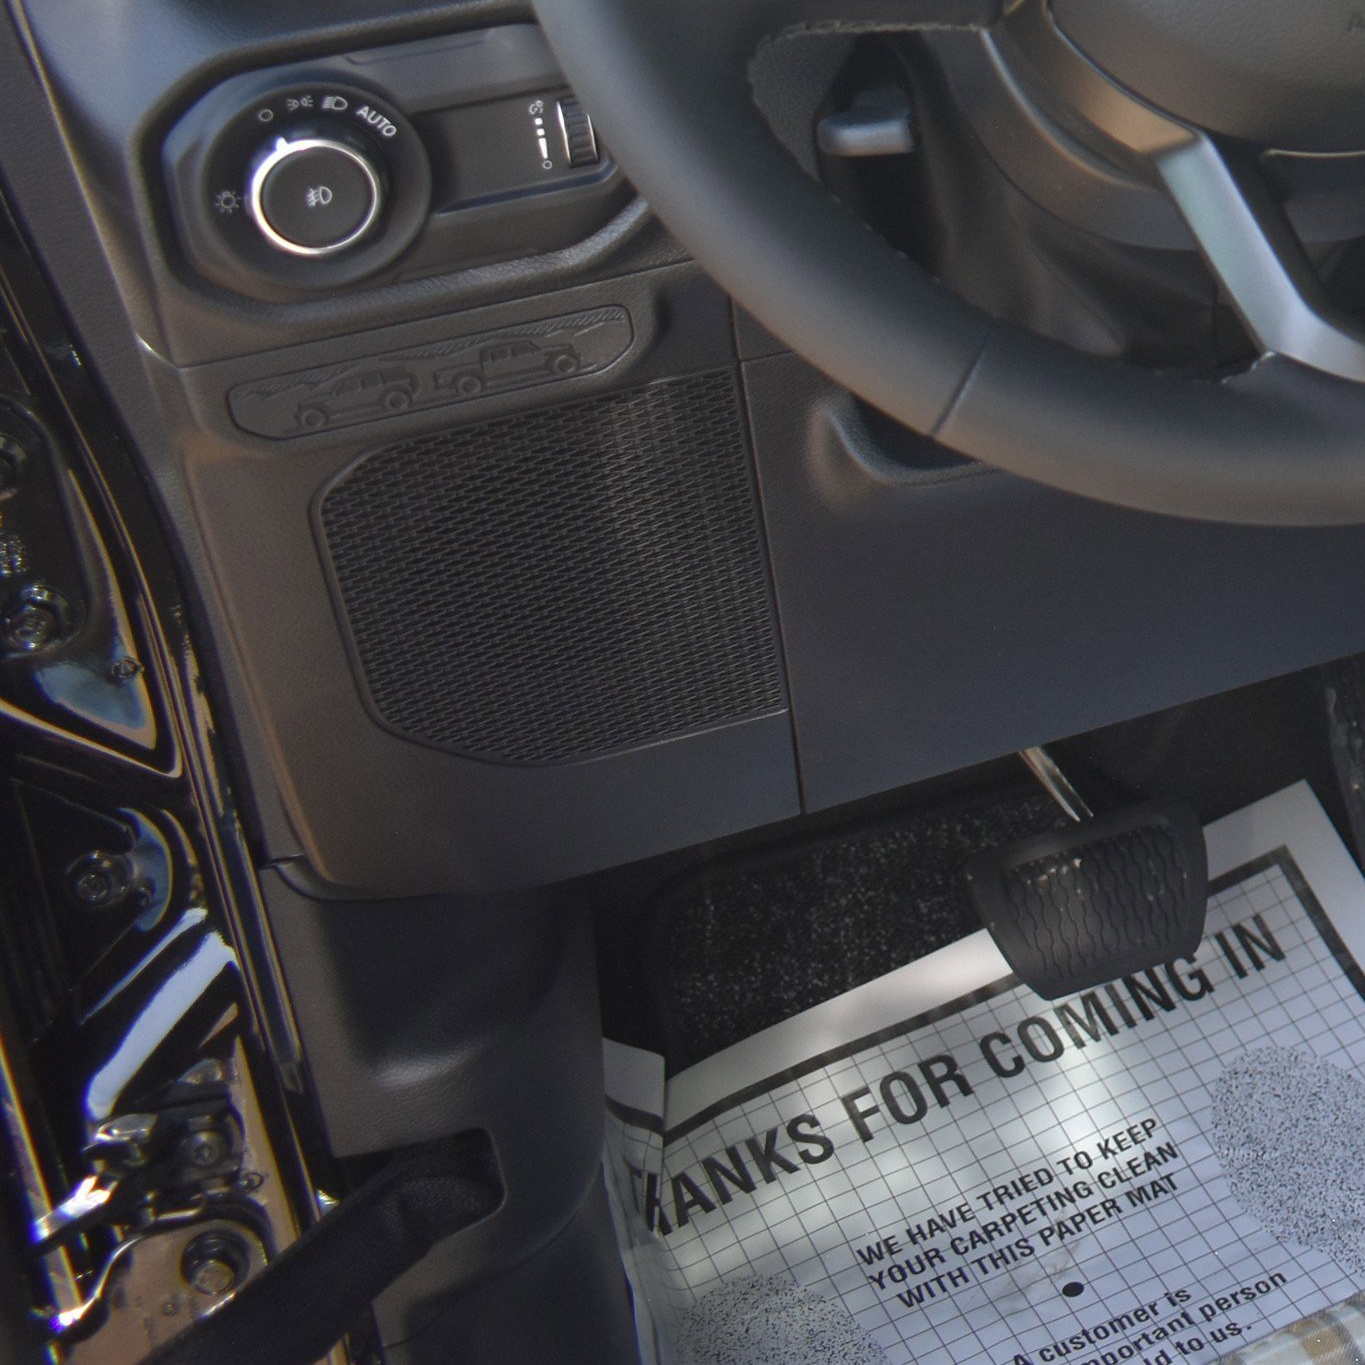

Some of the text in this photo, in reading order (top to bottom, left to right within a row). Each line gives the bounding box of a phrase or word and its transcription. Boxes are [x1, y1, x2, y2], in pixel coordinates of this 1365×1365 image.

[356, 104, 398, 138] AUTO
[840, 1053, 974, 1144] FOR
[979, 953, 1215, 1080] COMING
[1215, 913, 1288, 980] IN
[856, 1117, 1159, 1268] WE HAVE TRIED TO KEEP
[868, 1142, 1180, 1292] YOUR CARPETING CLEAN
[896, 1172, 1181, 1310] WITH THIS PAPER MAT
[1038, 1299, 1160, 1364] customer
[1164, 1288, 1192, 1307] is
[1174, 1336, 1206, 1357] to
[1212, 1319, 1254, 1344] us.
[1199, 1271, 1289, 1320] person
